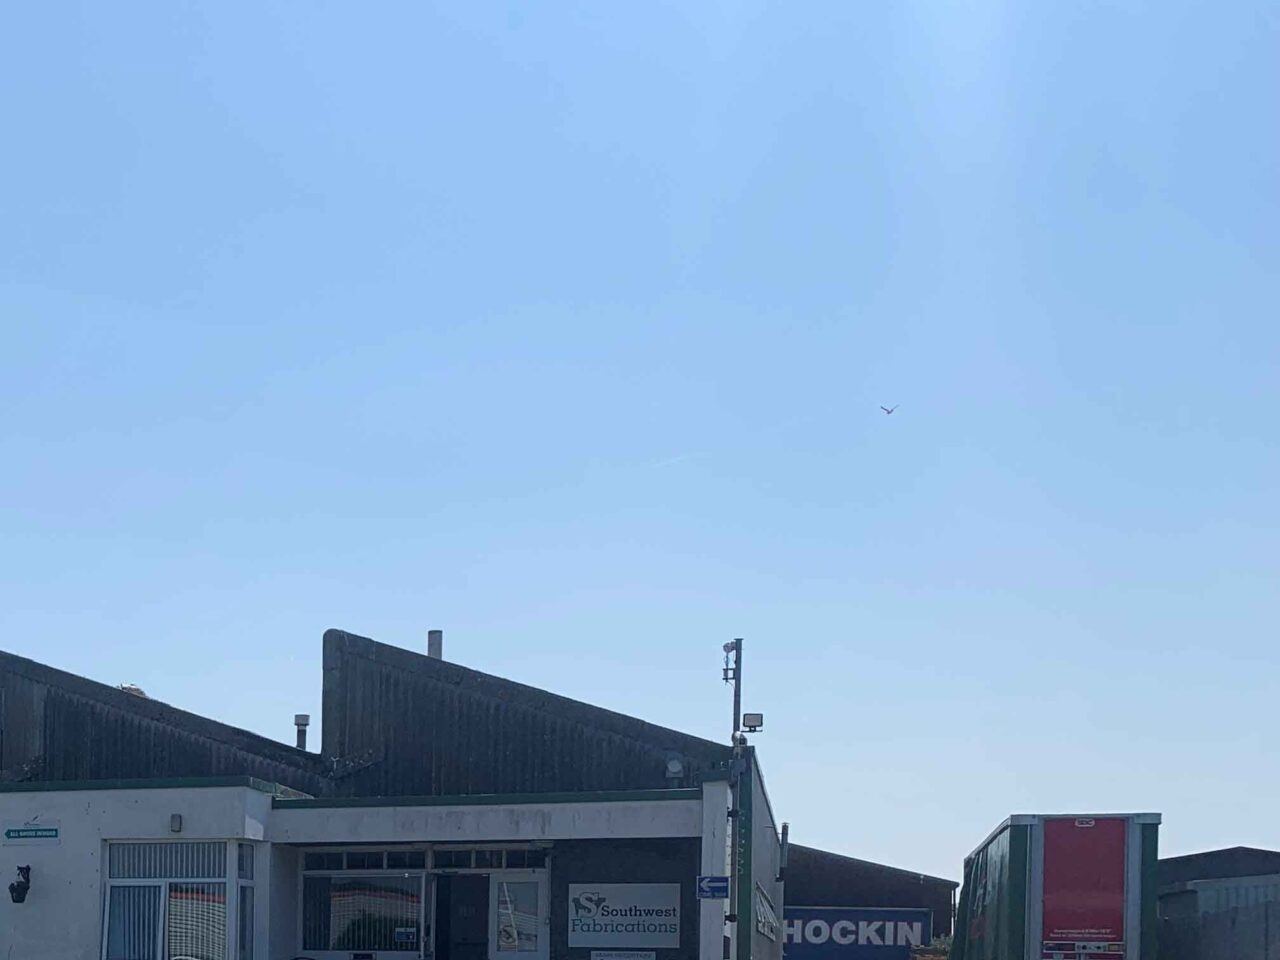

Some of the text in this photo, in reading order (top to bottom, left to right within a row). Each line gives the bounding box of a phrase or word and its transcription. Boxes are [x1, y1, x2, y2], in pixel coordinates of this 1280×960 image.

[601, 904, 677, 917] Southwest
[571, 918, 678, 933] Fabrications
[783, 919, 922, 946] HOCKIN
